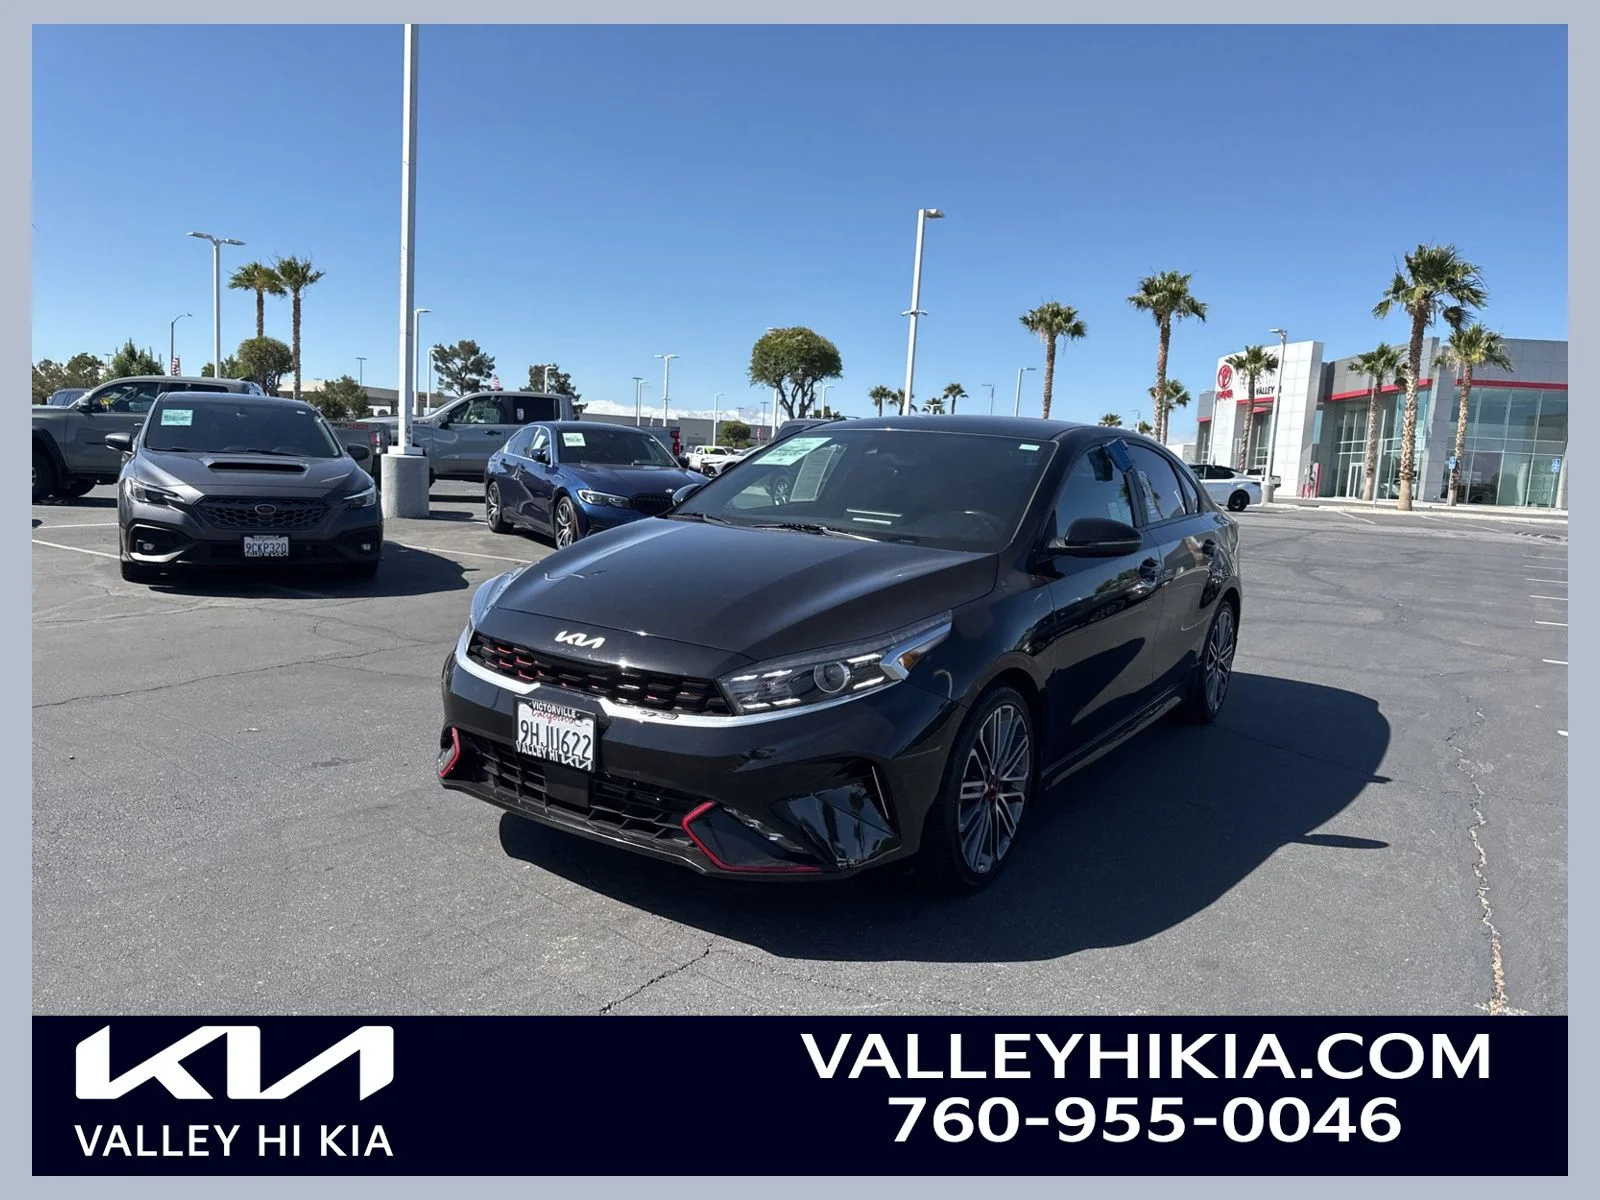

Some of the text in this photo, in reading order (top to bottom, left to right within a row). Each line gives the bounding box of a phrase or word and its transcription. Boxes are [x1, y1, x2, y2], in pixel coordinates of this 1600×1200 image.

[1256, 385, 1275, 396] VALLEY
[245, 542, 287, 554] 9CKP320
[554, 630, 606, 649] KIA
[531, 700, 577, 718] VICTORVILLE
[520, 719, 592, 761] 9HJU622
[515, 739, 592, 772] VALLEY HI KIA
